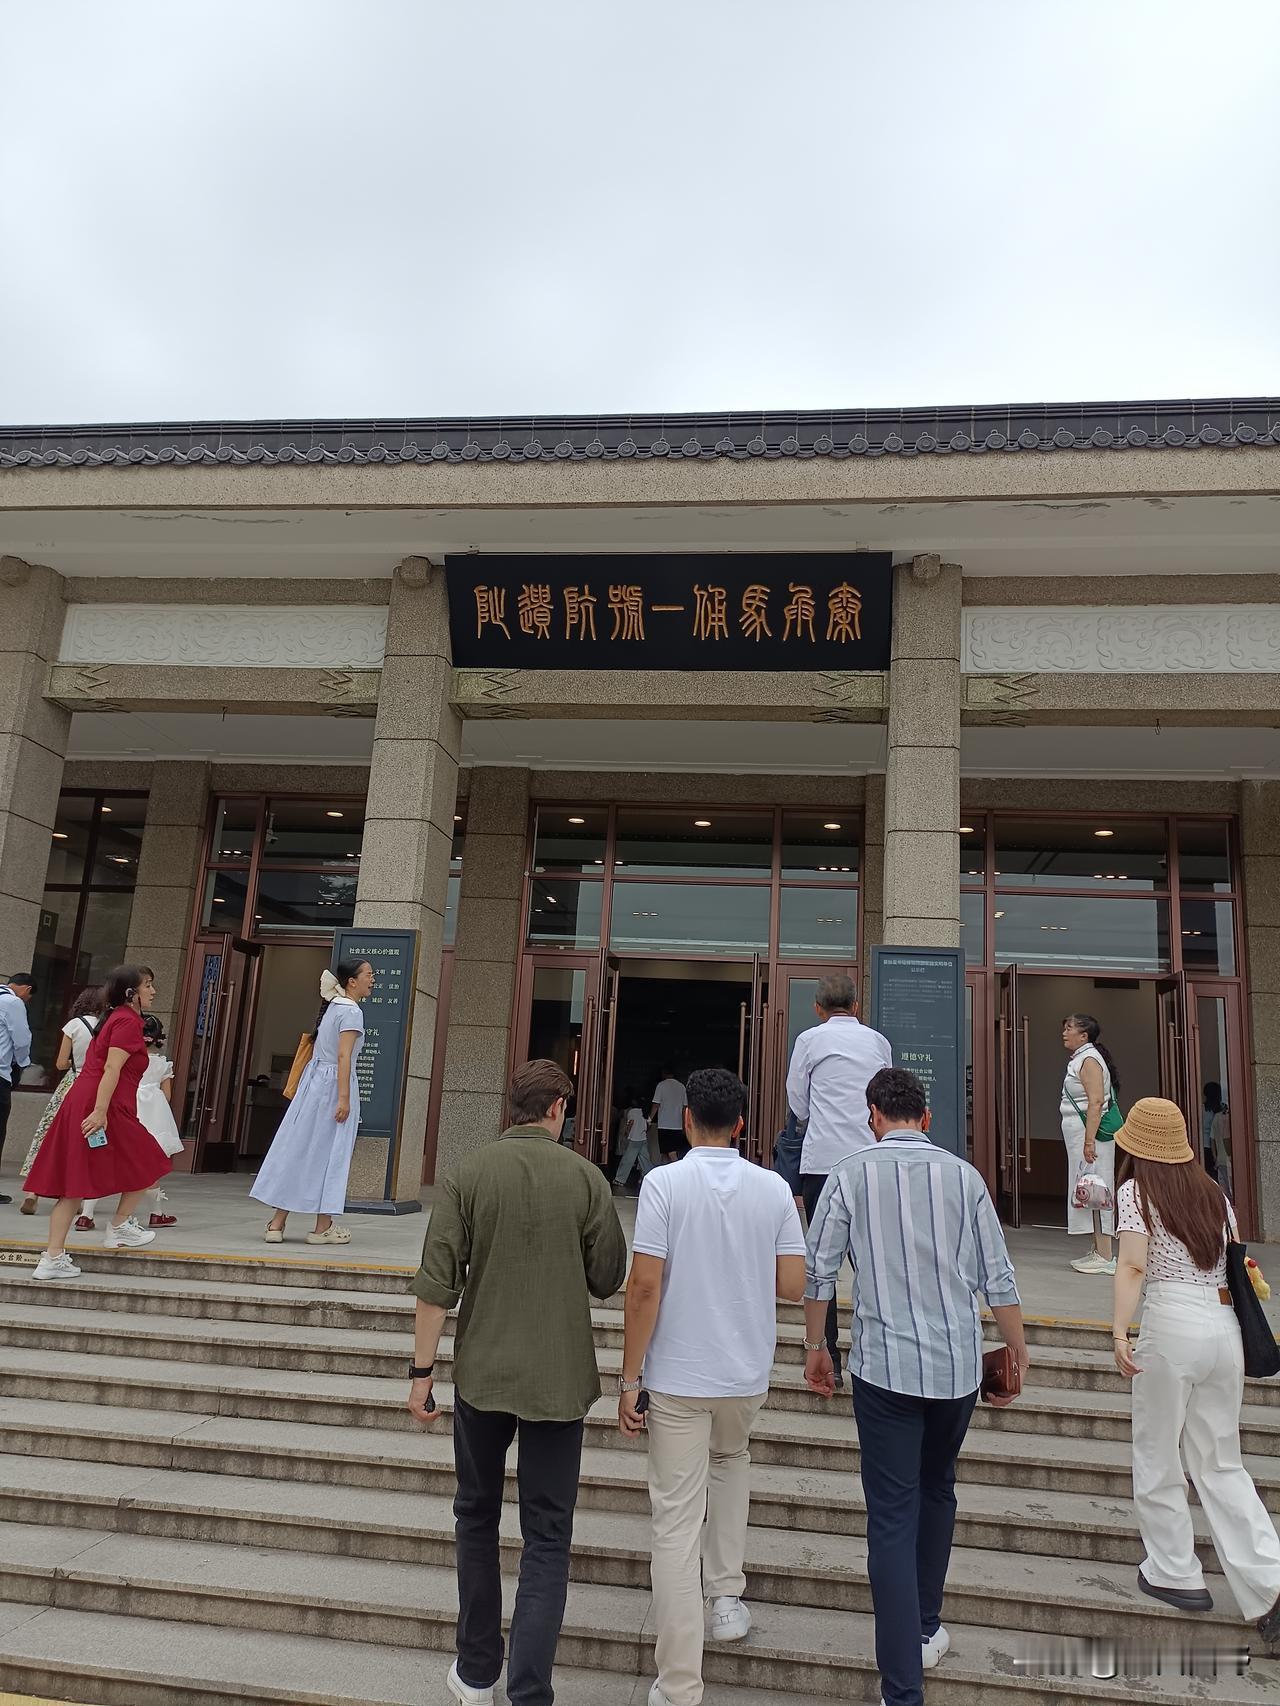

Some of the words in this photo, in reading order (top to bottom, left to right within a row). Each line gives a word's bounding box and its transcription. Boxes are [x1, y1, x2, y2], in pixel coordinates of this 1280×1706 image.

[349, 947, 400, 955] 社会主义核心价值观
